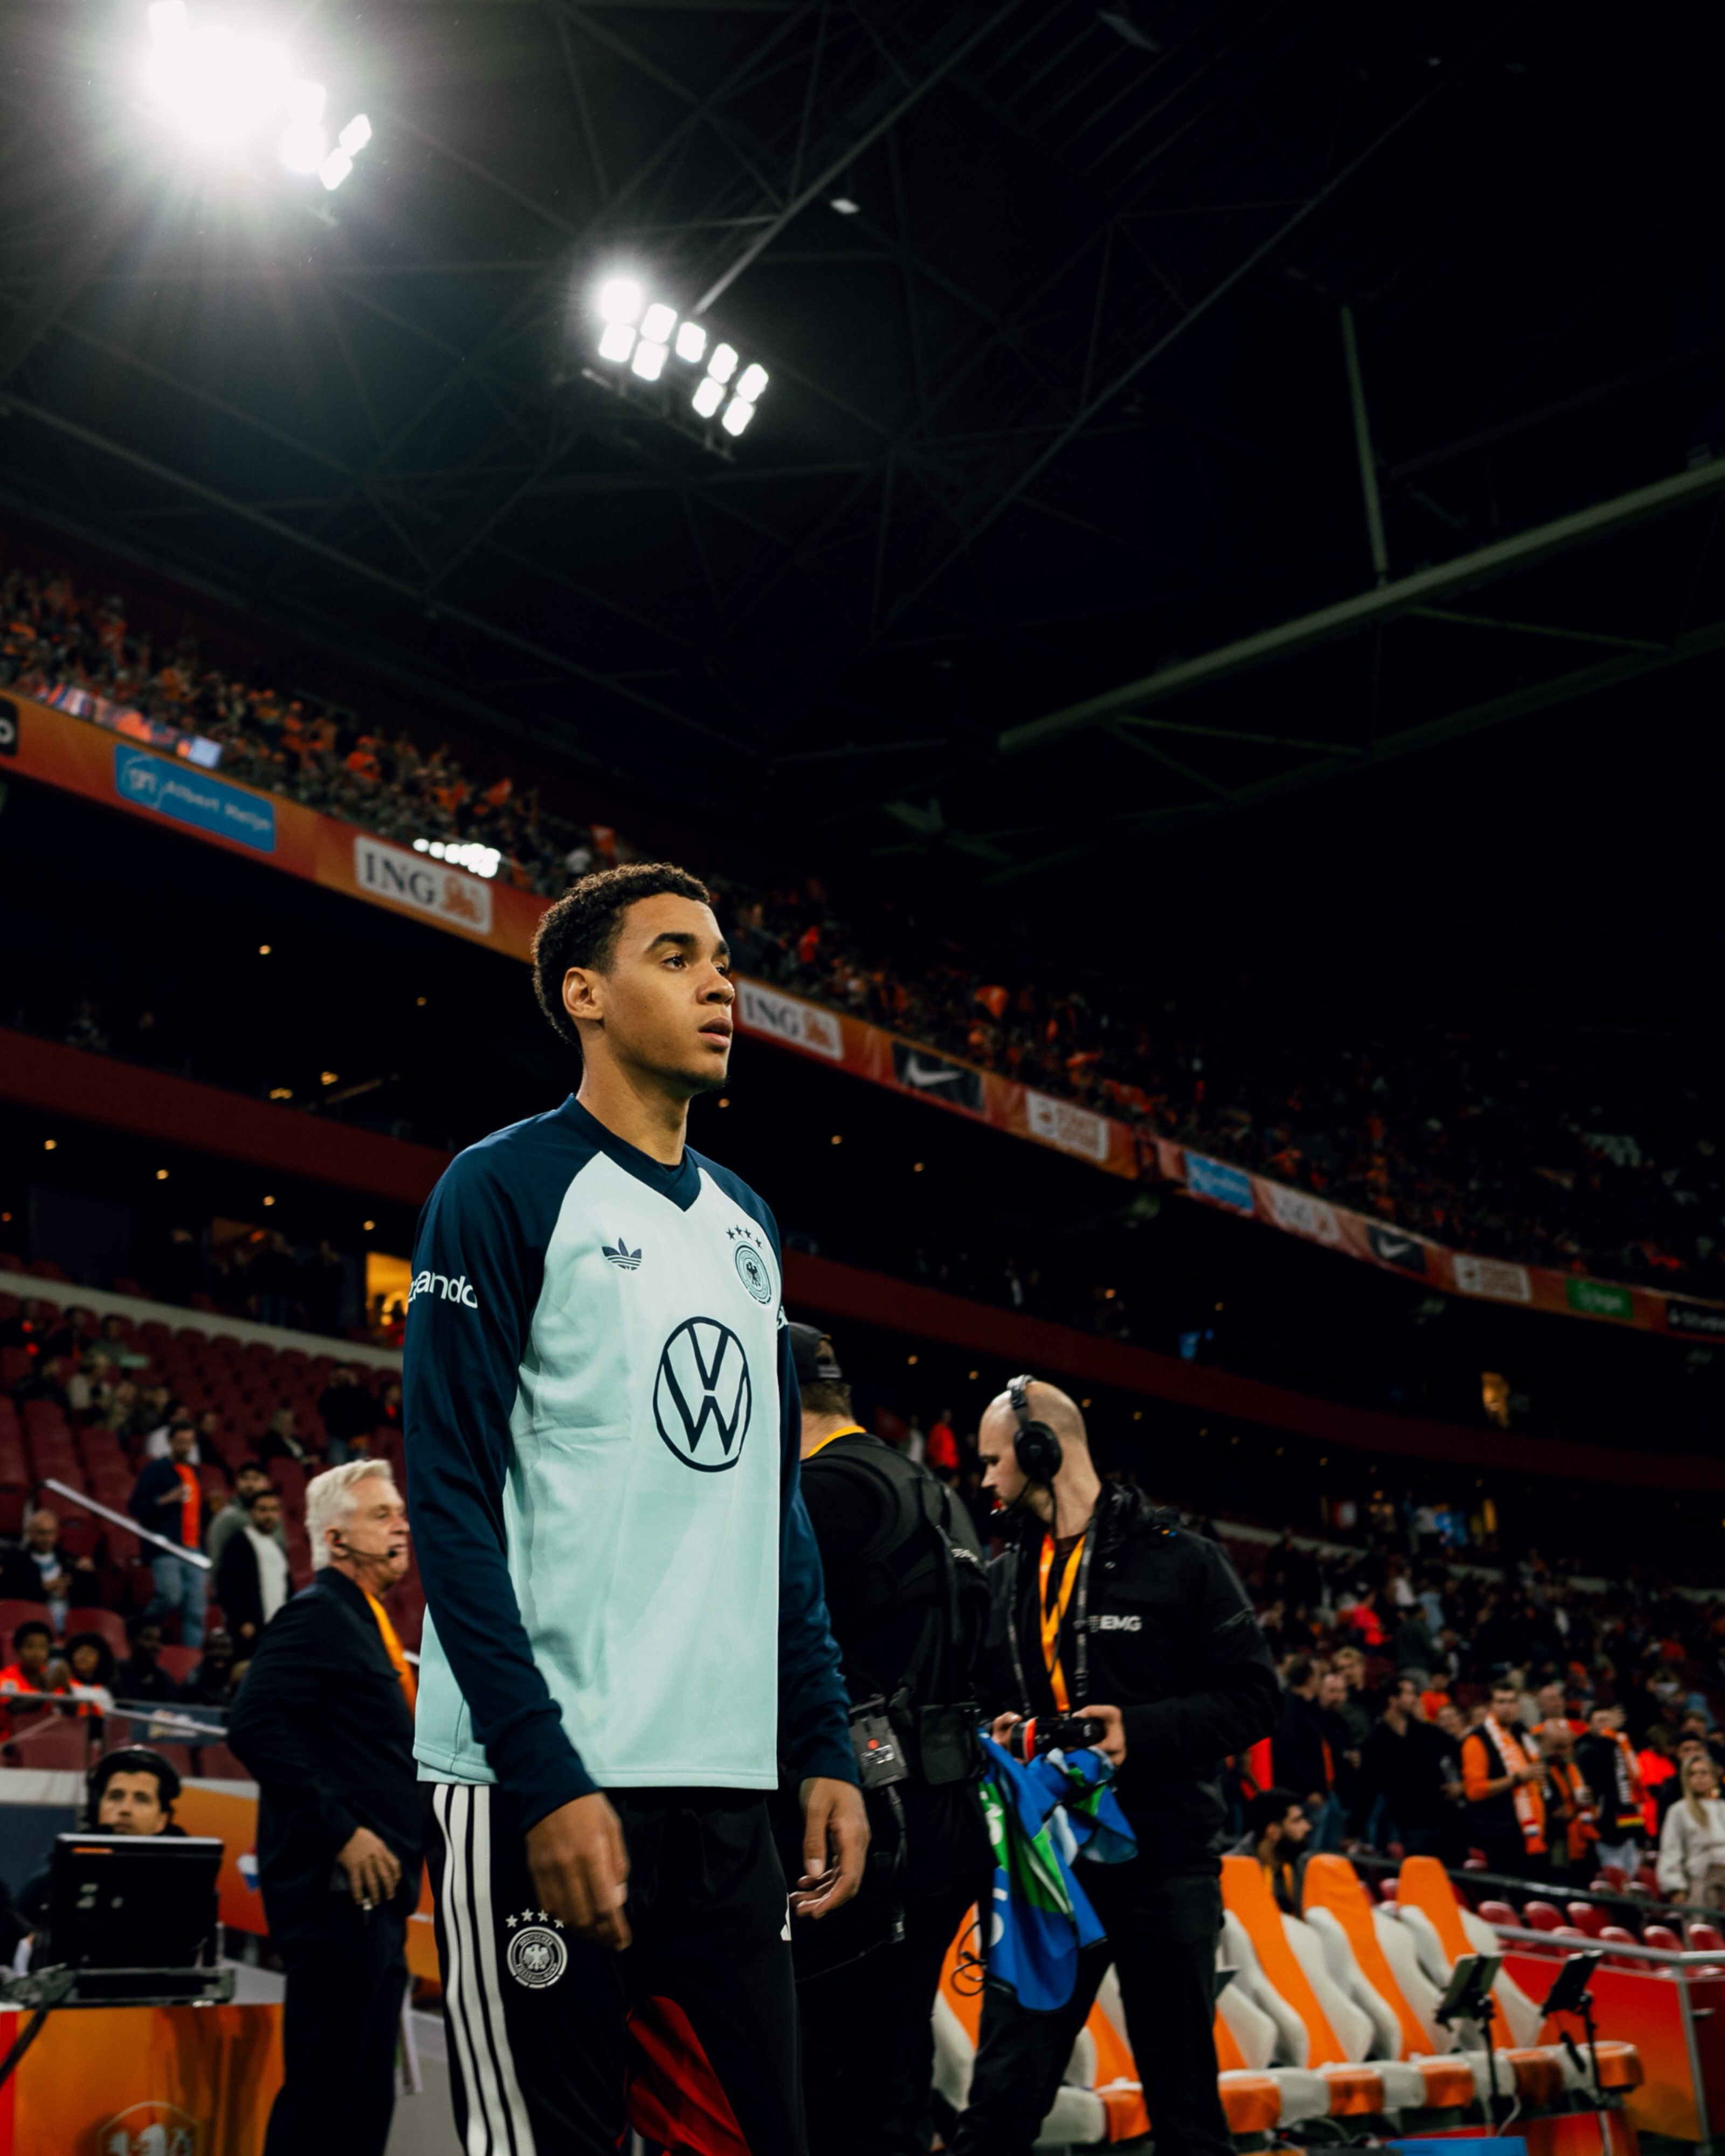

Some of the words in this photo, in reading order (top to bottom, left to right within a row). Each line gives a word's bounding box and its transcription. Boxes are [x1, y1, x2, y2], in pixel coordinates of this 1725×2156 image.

[365, 853, 436, 906] ING
[745, 992, 799, 1036] ING
[1100, 1615, 1142, 1632] EMG
